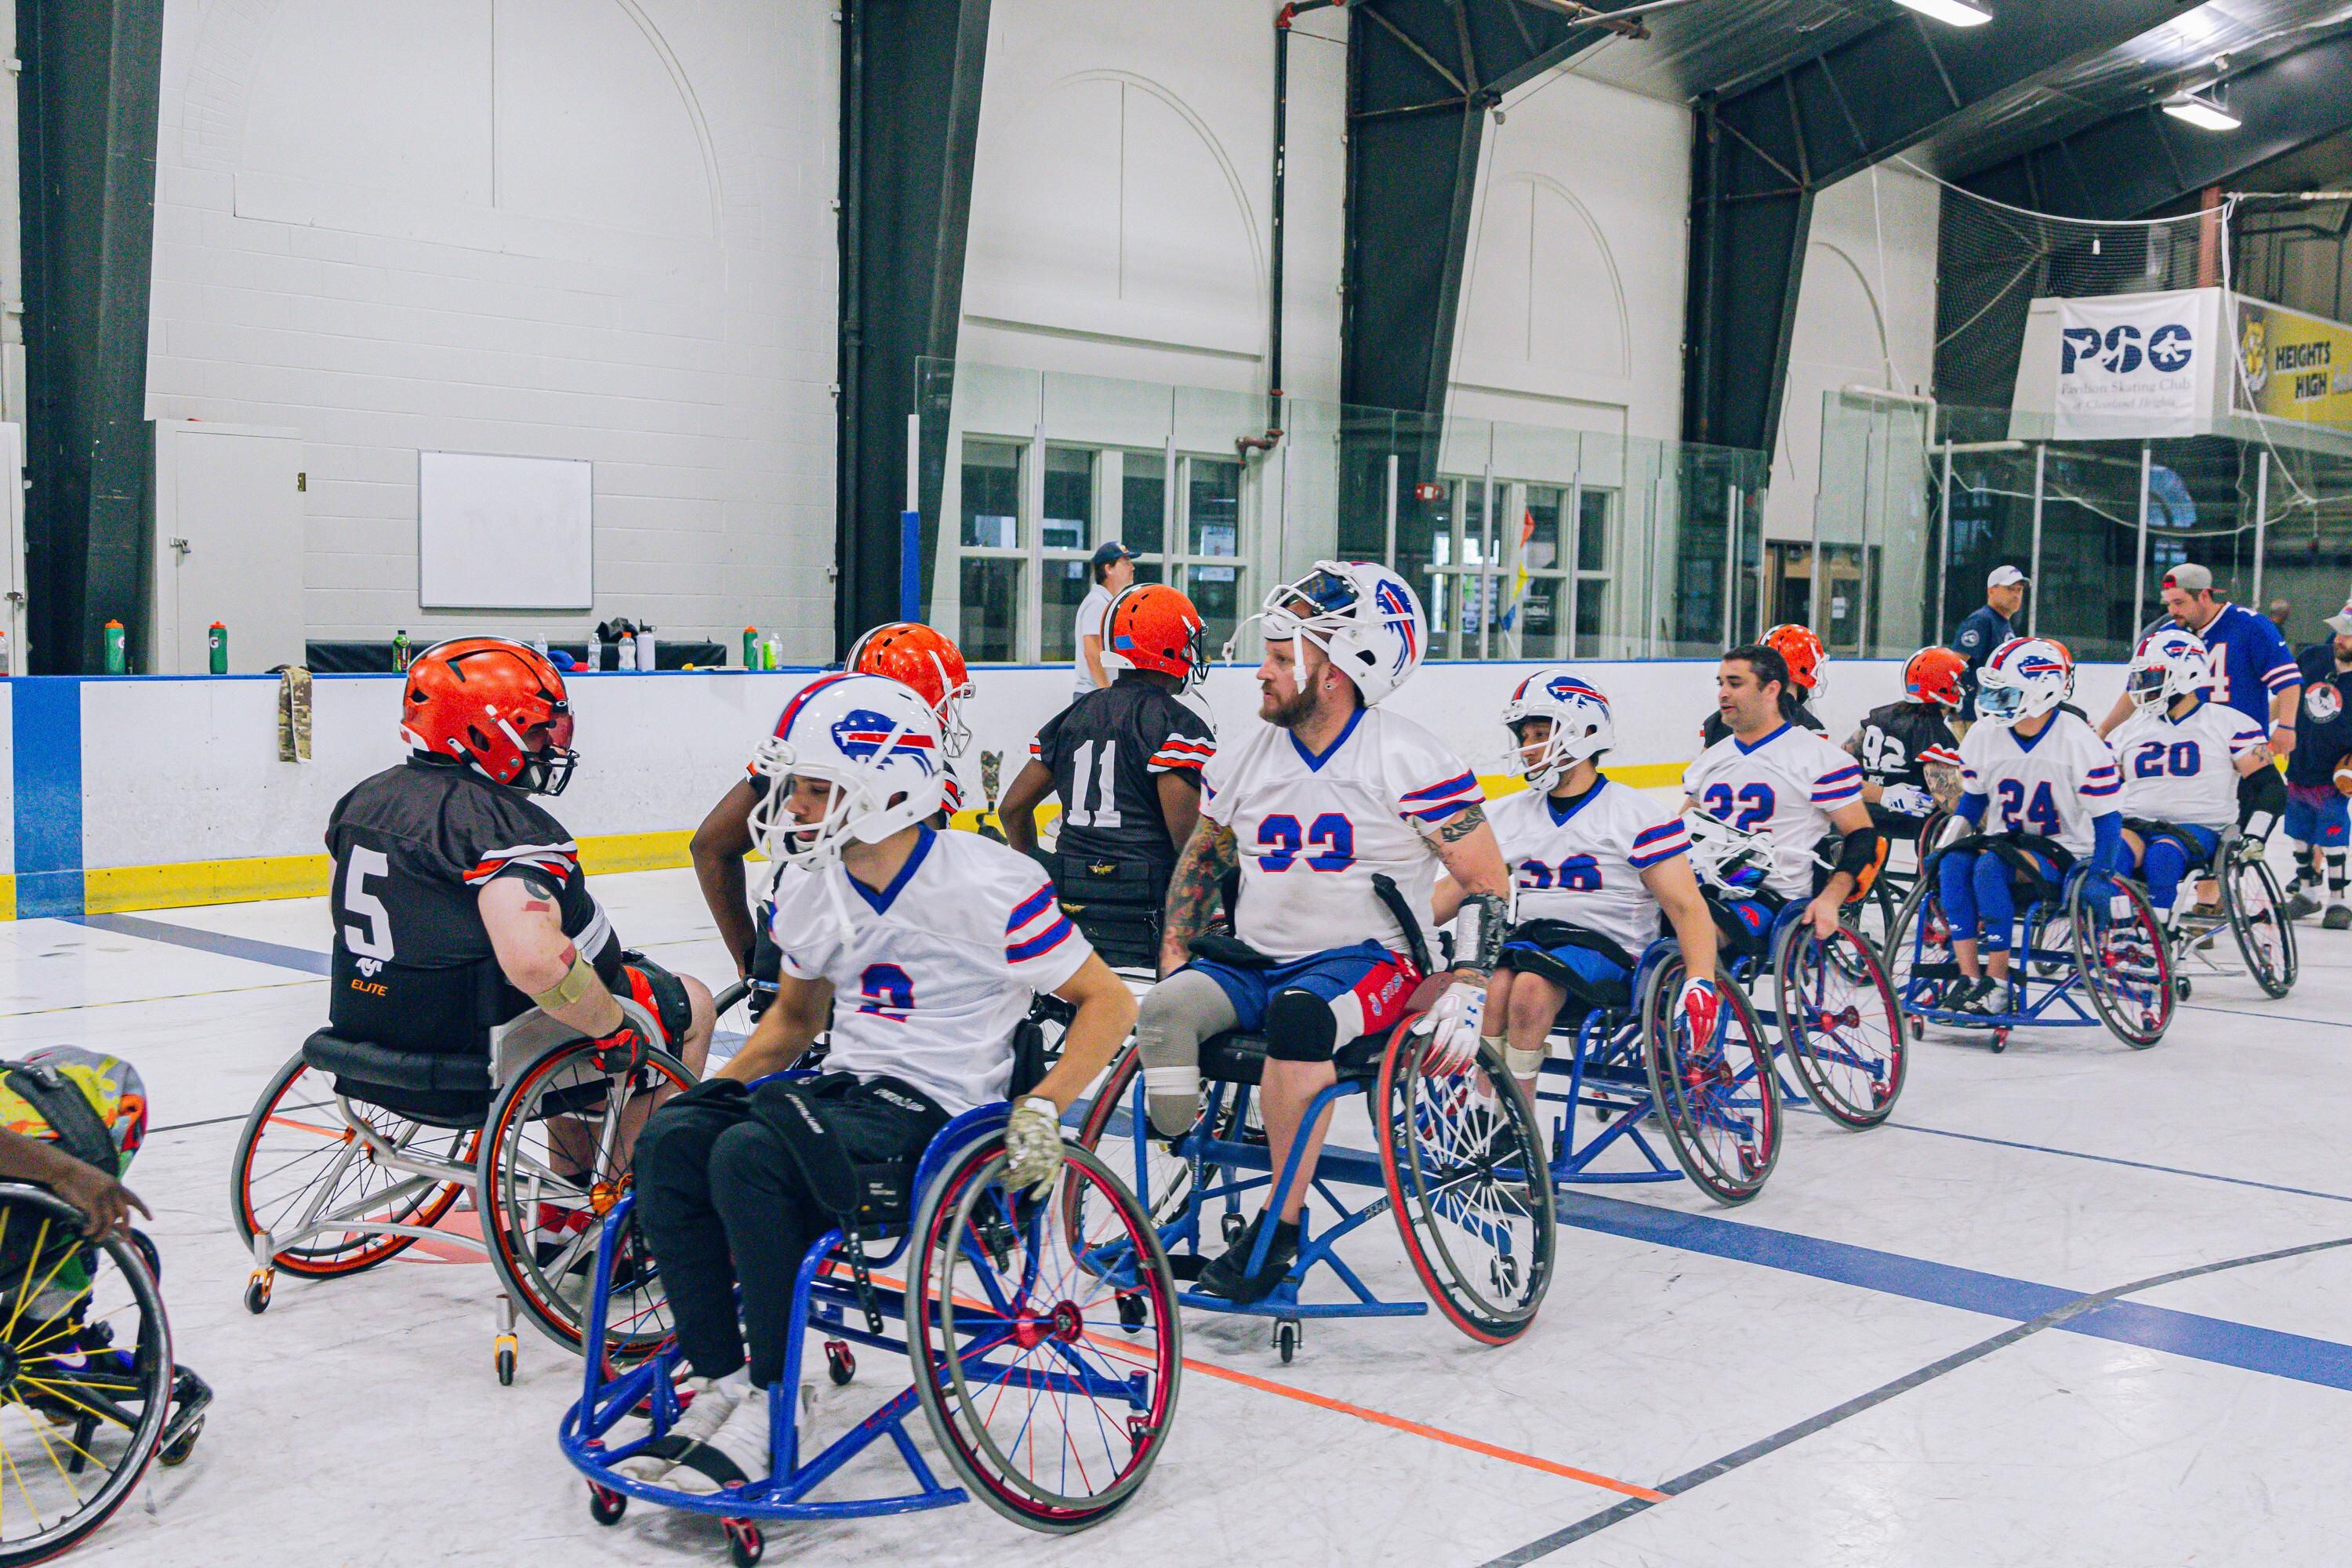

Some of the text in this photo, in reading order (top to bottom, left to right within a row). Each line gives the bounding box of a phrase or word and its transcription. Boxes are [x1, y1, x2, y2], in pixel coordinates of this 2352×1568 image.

[2275, 340, 2331, 371] HEIGHTS
[2061, 377, 2190, 395] Pavilion Skating Club
[2295, 372, 2328, 400] HIGH
[1862, 724, 1911, 773] 92
[2134, 740, 2201, 779] 20
[1066, 739, 1121, 828] 11
[1704, 782, 1775, 833] 22
[1998, 778, 2061, 836] 24
[1257, 812, 1356, 873] 33
[344, 844, 395, 963] 5
[350, 978, 390, 1005] ELITE
[855, 962, 915, 1024] 2
